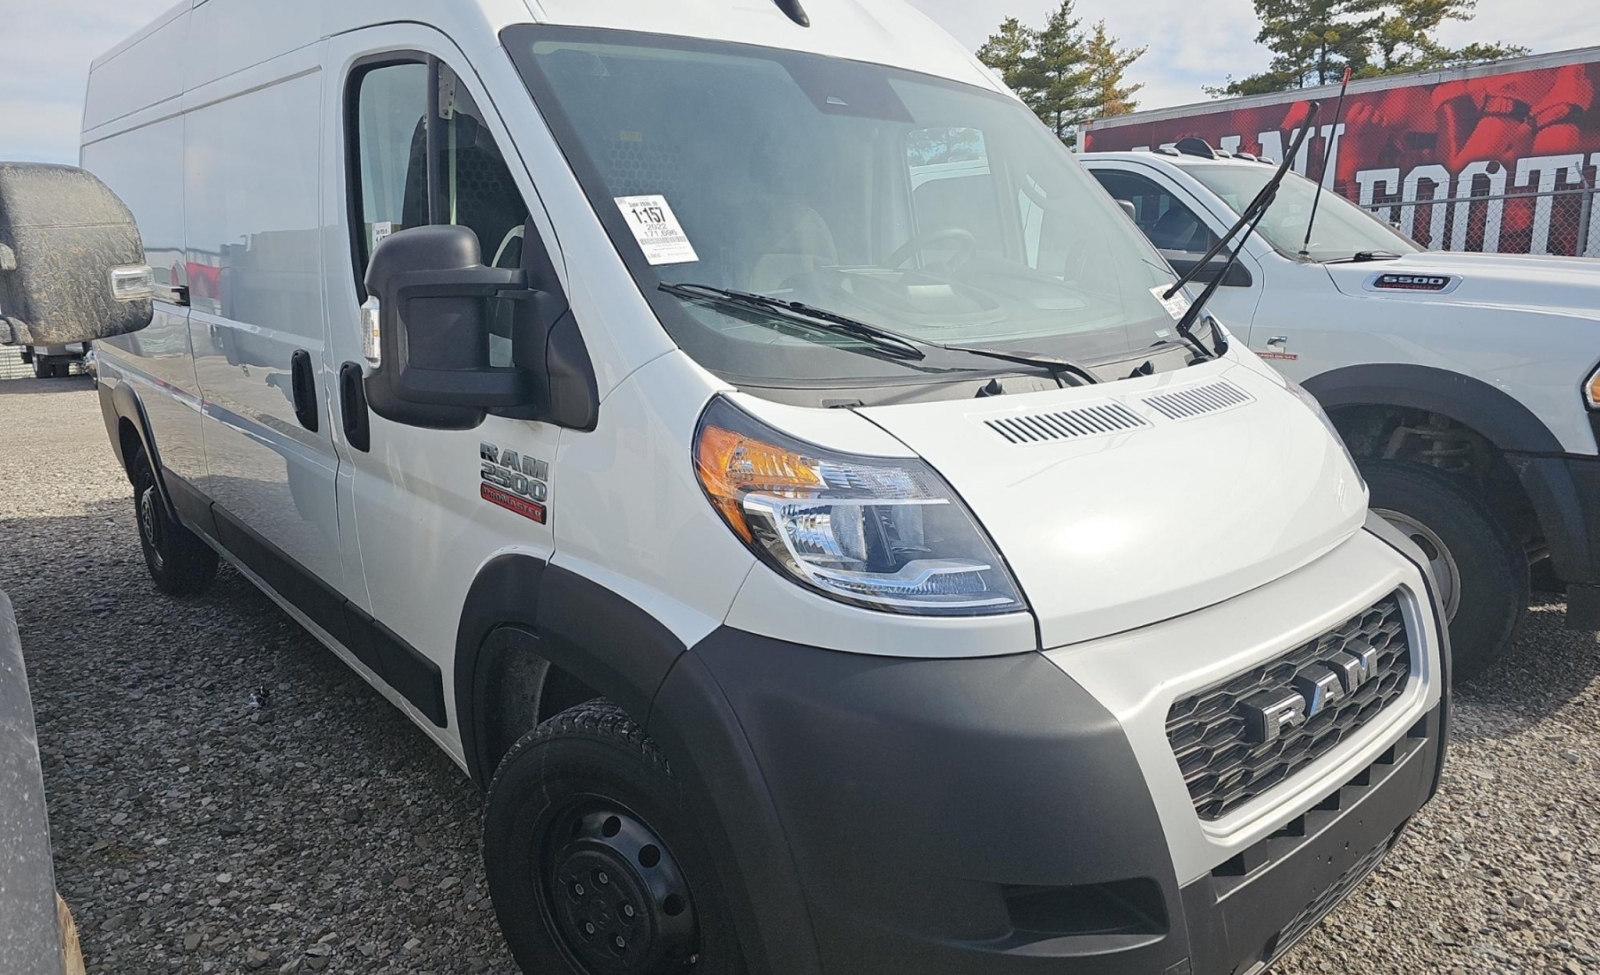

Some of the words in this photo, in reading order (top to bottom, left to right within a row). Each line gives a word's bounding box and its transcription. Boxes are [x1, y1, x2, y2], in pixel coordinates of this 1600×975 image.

[631, 206, 666, 224] 1:157
[1356, 153, 1600, 255] FOOT
[646, 223, 667, 231] 2022
[1383, 276, 1444, 285] 5500
[480, 440, 549, 482] RAM
[480, 461, 548, 502] 2500
[482, 487, 542, 517] PROMASTER
[1260, 645, 1378, 742] RAM
